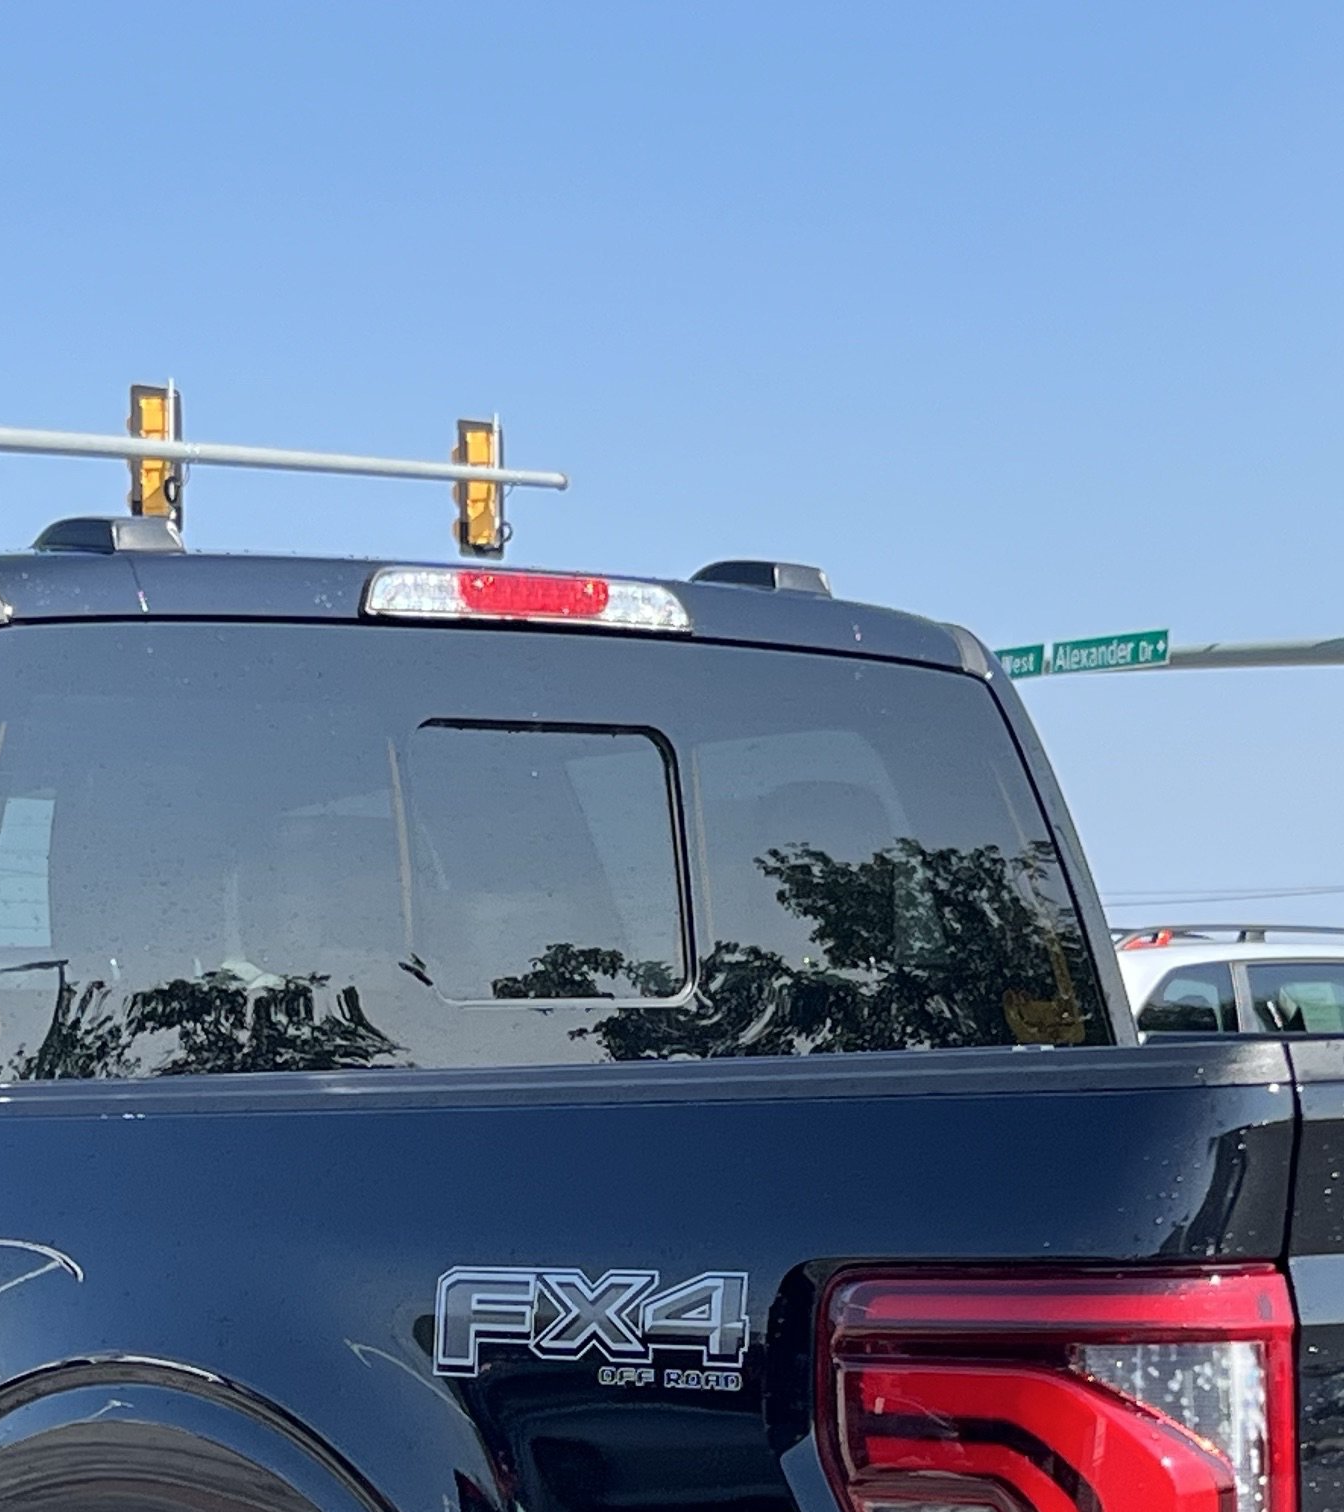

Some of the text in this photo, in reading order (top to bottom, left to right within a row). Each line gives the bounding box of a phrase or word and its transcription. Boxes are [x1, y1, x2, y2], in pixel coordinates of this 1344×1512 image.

[1000, 638, 1155, 674] West Alexander Dr
[432, 1265, 750, 1378] FX4
[597, 1366, 744, 1391] OFF ROAD
